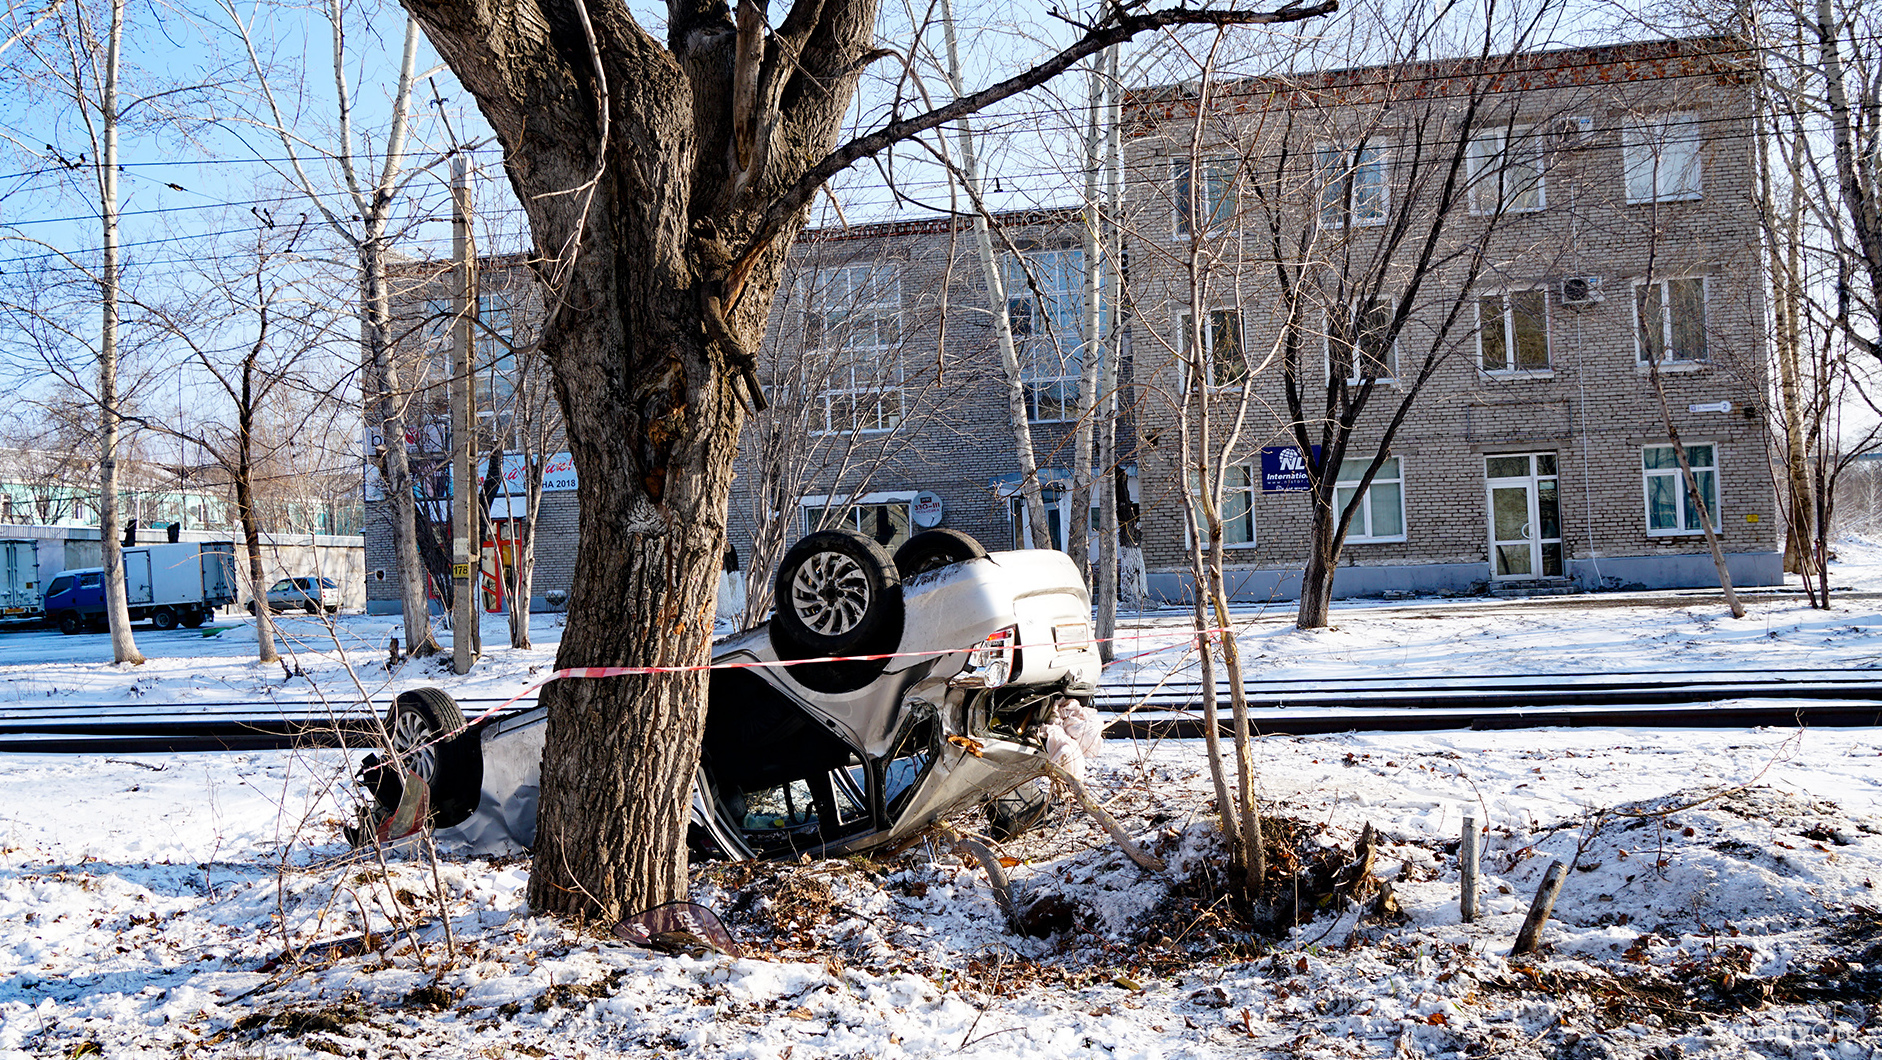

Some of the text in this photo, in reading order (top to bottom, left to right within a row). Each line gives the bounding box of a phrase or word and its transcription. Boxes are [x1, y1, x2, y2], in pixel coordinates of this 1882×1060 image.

[1279, 456, 1305, 471] NL
[556, 479, 576, 488] 2018
[453, 565, 468, 575] 178
